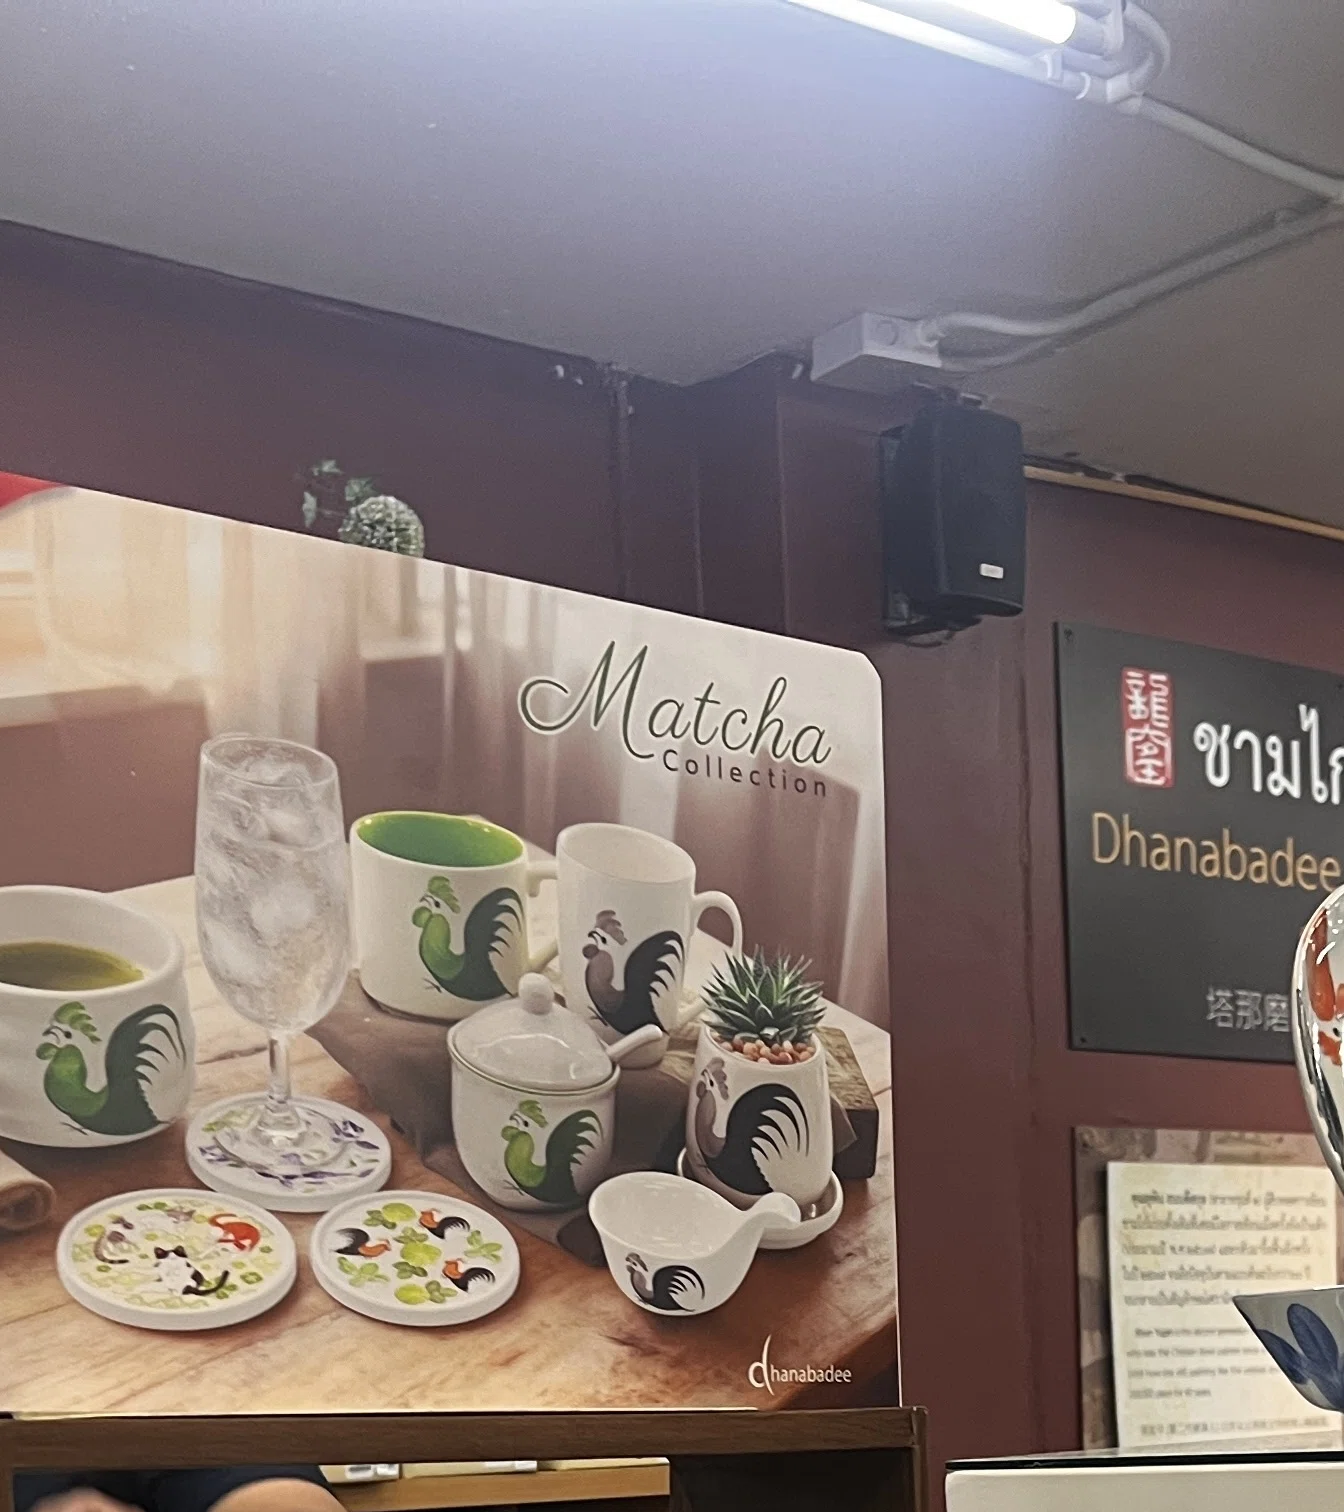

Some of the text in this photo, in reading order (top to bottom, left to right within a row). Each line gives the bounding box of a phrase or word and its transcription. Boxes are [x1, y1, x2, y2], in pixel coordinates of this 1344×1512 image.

[519, 640, 833, 765] Matcha
[662, 748, 827, 798] Collection
[1091, 811, 1342, 892] Dhanabadee
[748, 1334, 852, 1396] dhanabadee
